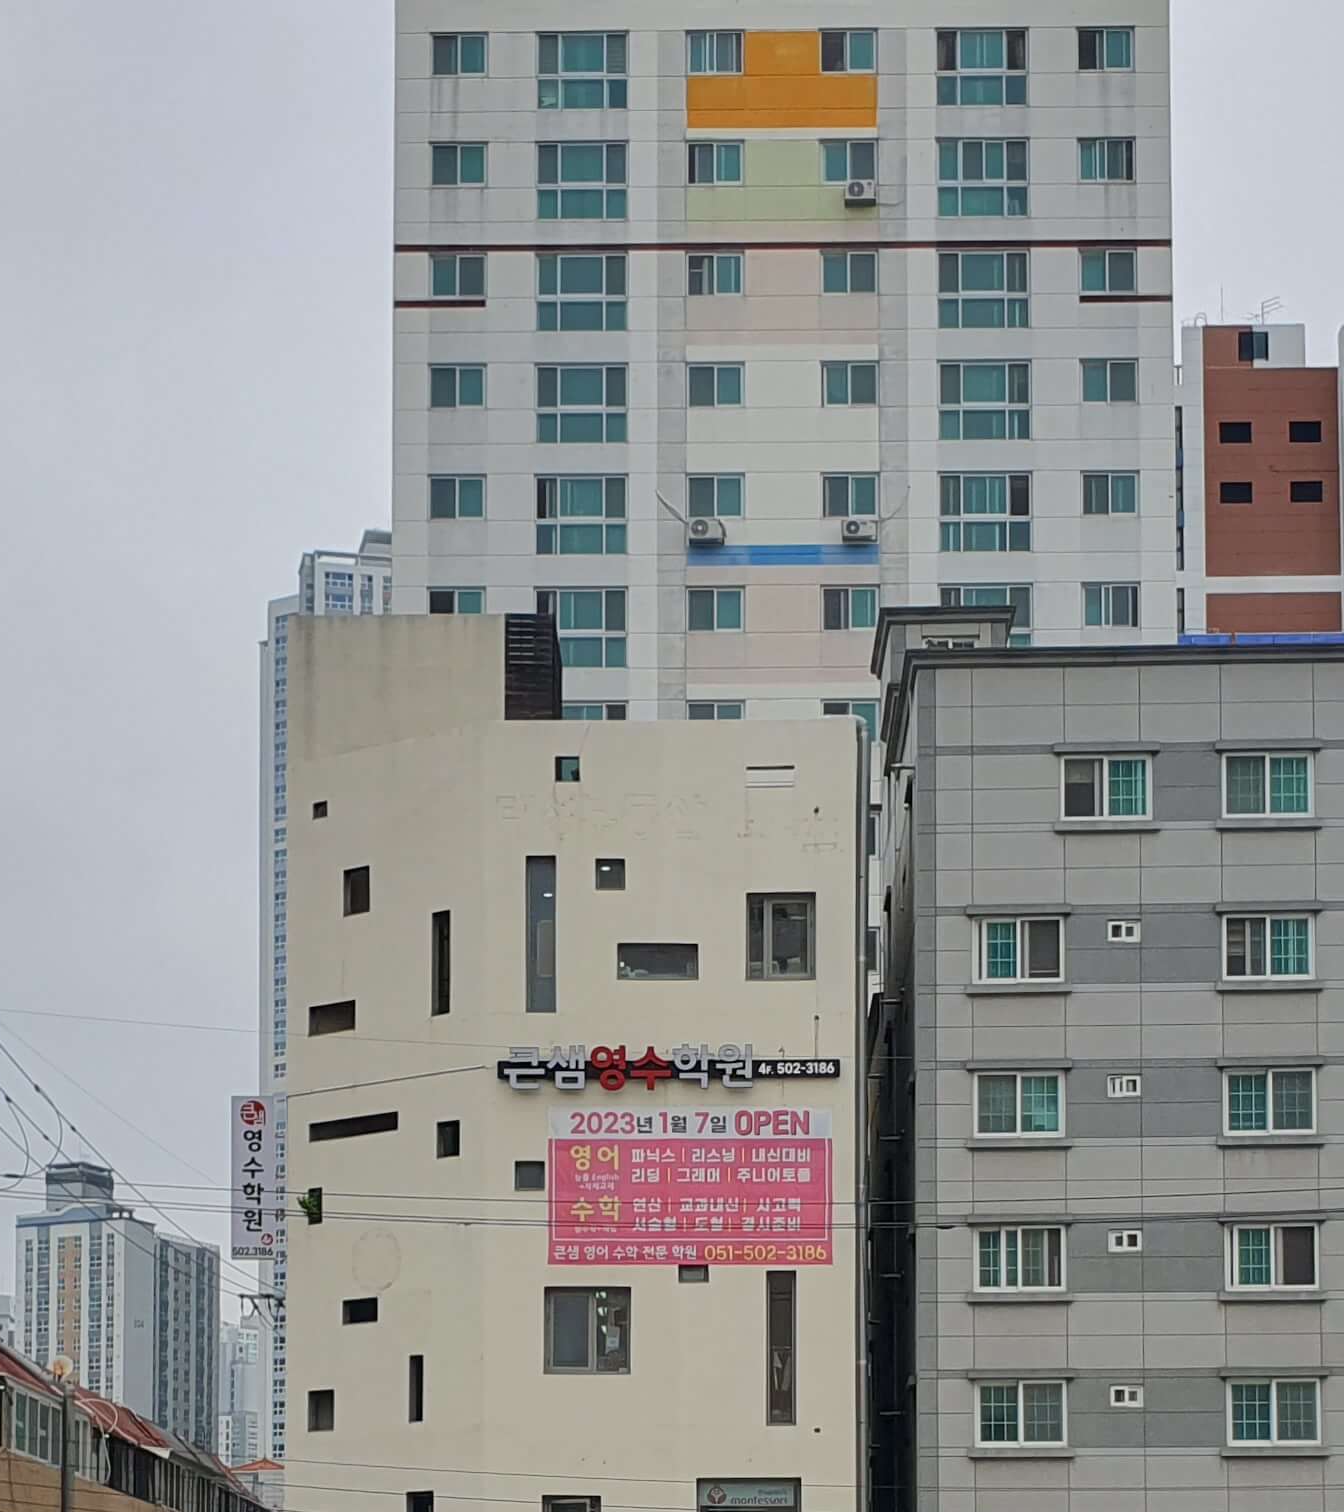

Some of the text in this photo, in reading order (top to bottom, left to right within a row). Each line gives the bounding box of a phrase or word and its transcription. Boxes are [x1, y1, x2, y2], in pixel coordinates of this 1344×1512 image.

[503, 1044, 754, 1092] 큰샘영수학원
[777, 1062, 836, 1075] 502-3186
[570, 1110, 811, 1136] 2023년 1월 7일 OPEN
[570, 1144, 620, 1172] 영어
[242, 1130, 264, 1232] 영수학원
[570, 1195, 621, 1222] 수학
[704, 1245, 827, 1261] 051-502-3186
